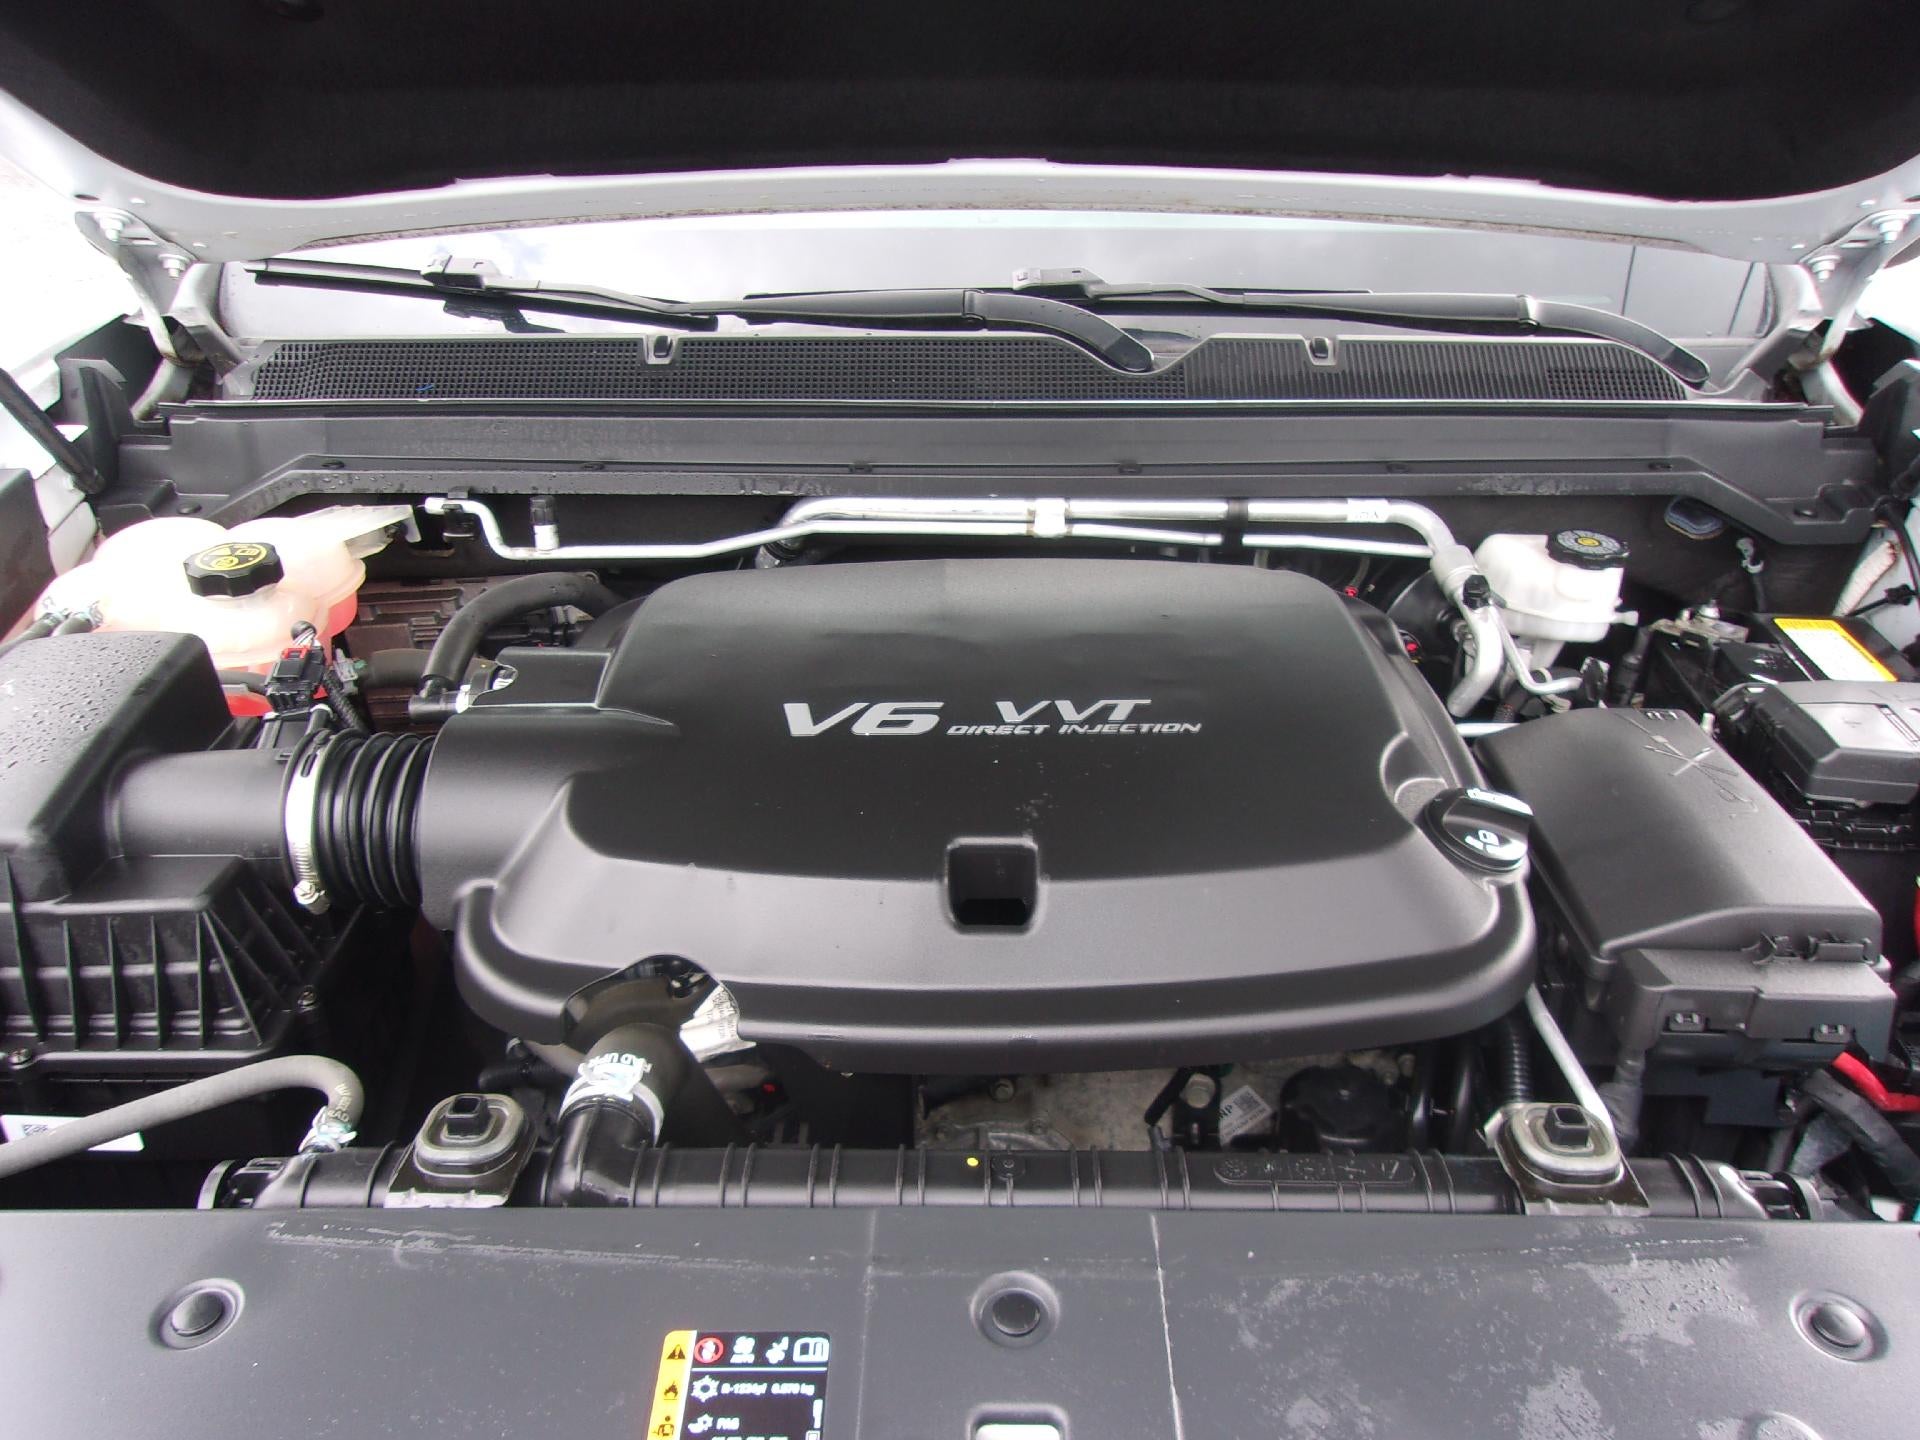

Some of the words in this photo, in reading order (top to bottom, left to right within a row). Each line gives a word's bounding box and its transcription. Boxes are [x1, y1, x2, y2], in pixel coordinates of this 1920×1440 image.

[783, 702, 945, 737] V6
[995, 699, 1153, 723] VVT
[946, 723, 1051, 736] DIRECT
[1058, 722, 1203, 735] INJECTION
